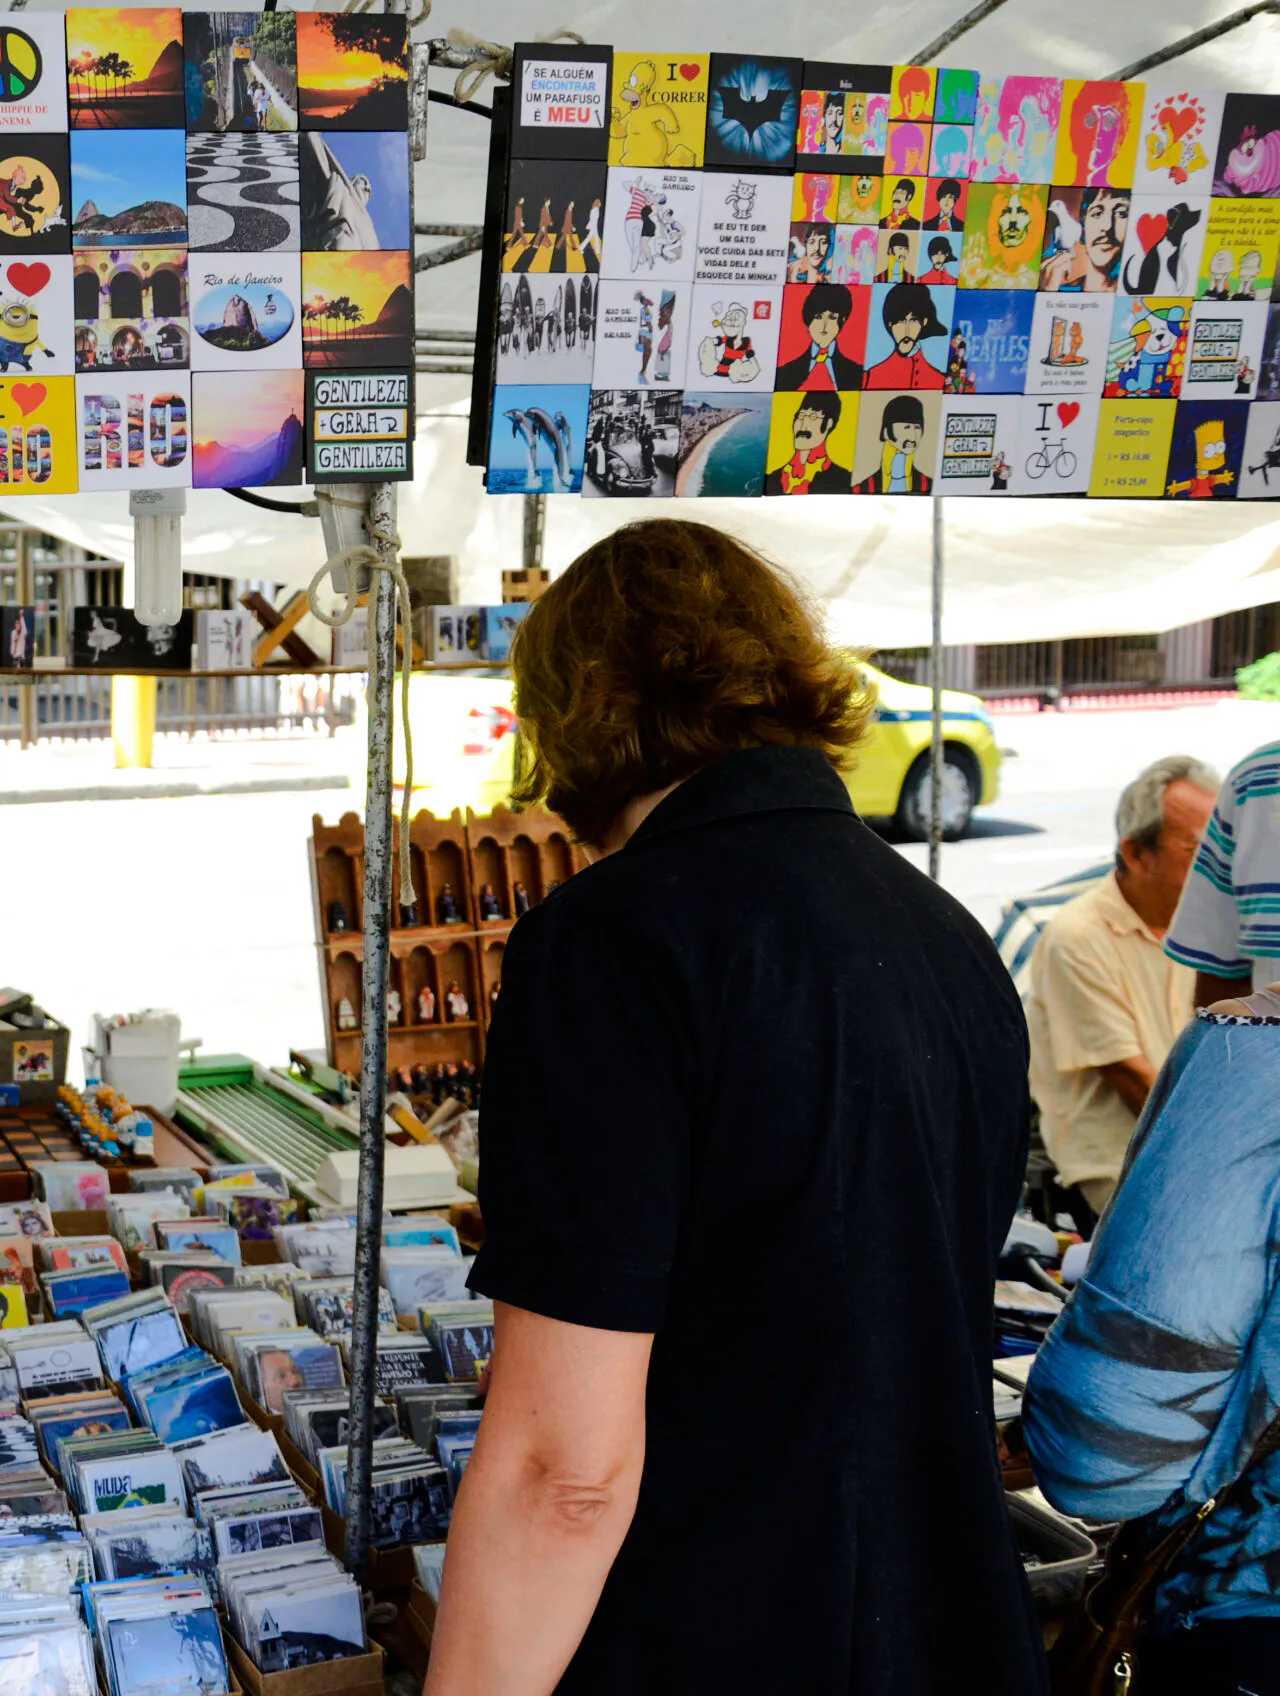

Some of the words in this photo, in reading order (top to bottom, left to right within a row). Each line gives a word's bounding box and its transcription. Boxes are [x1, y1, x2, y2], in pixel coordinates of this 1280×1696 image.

[533, 68, 546, 79] SE
[551, 66, 594, 79] ALGUÉM
[667, 63, 677, 81] I
[531, 80, 596, 91] ENCONTRAR
[526, 93, 541, 103] UM
[545, 94, 600, 104] PARAFUSO
[652, 91, 705, 103] CORRER
[1, 104, 32, 113] HIPPIE
[35, 104, 48, 113] DE
[534, 109, 541, 122] É
[548, 107, 591, 123] MEU
[726, 223, 736, 231] EU
[739, 223, 749, 231] TE
[751, 224, 767, 232] DER
[734, 236, 755, 244] GATO
[699, 246, 720, 255] VOCÊ
[722, 247, 746, 256] CUIDA
[749, 248, 764, 256] DAS
[766, 249, 785, 257] SETE
[705, 259, 728, 267] VIDAS
[730, 260, 749, 268] DELE
[203, 274, 223, 286] Rio
[228, 274, 240, 285] de
[244, 272, 283, 290] Janeiro
[697, 271, 733, 280] ESQUECE
[735, 272, 745, 280] DA
[748, 272, 777, 281] MINHA?
[959, 320, 1029, 368] BEATLES
[316, 379, 408, 404] GENTILEZA
[330, 412, 378, 434] GERA
[1035, 403, 1054, 431] I
[83, 393, 188, 469] RIO
[949, 418, 995, 434] GENTILEZA
[319, 446, 405, 469] GENTILEZA
[945, 460, 990, 473] GENTILEZA
[439, 614, 479, 651] RIO
